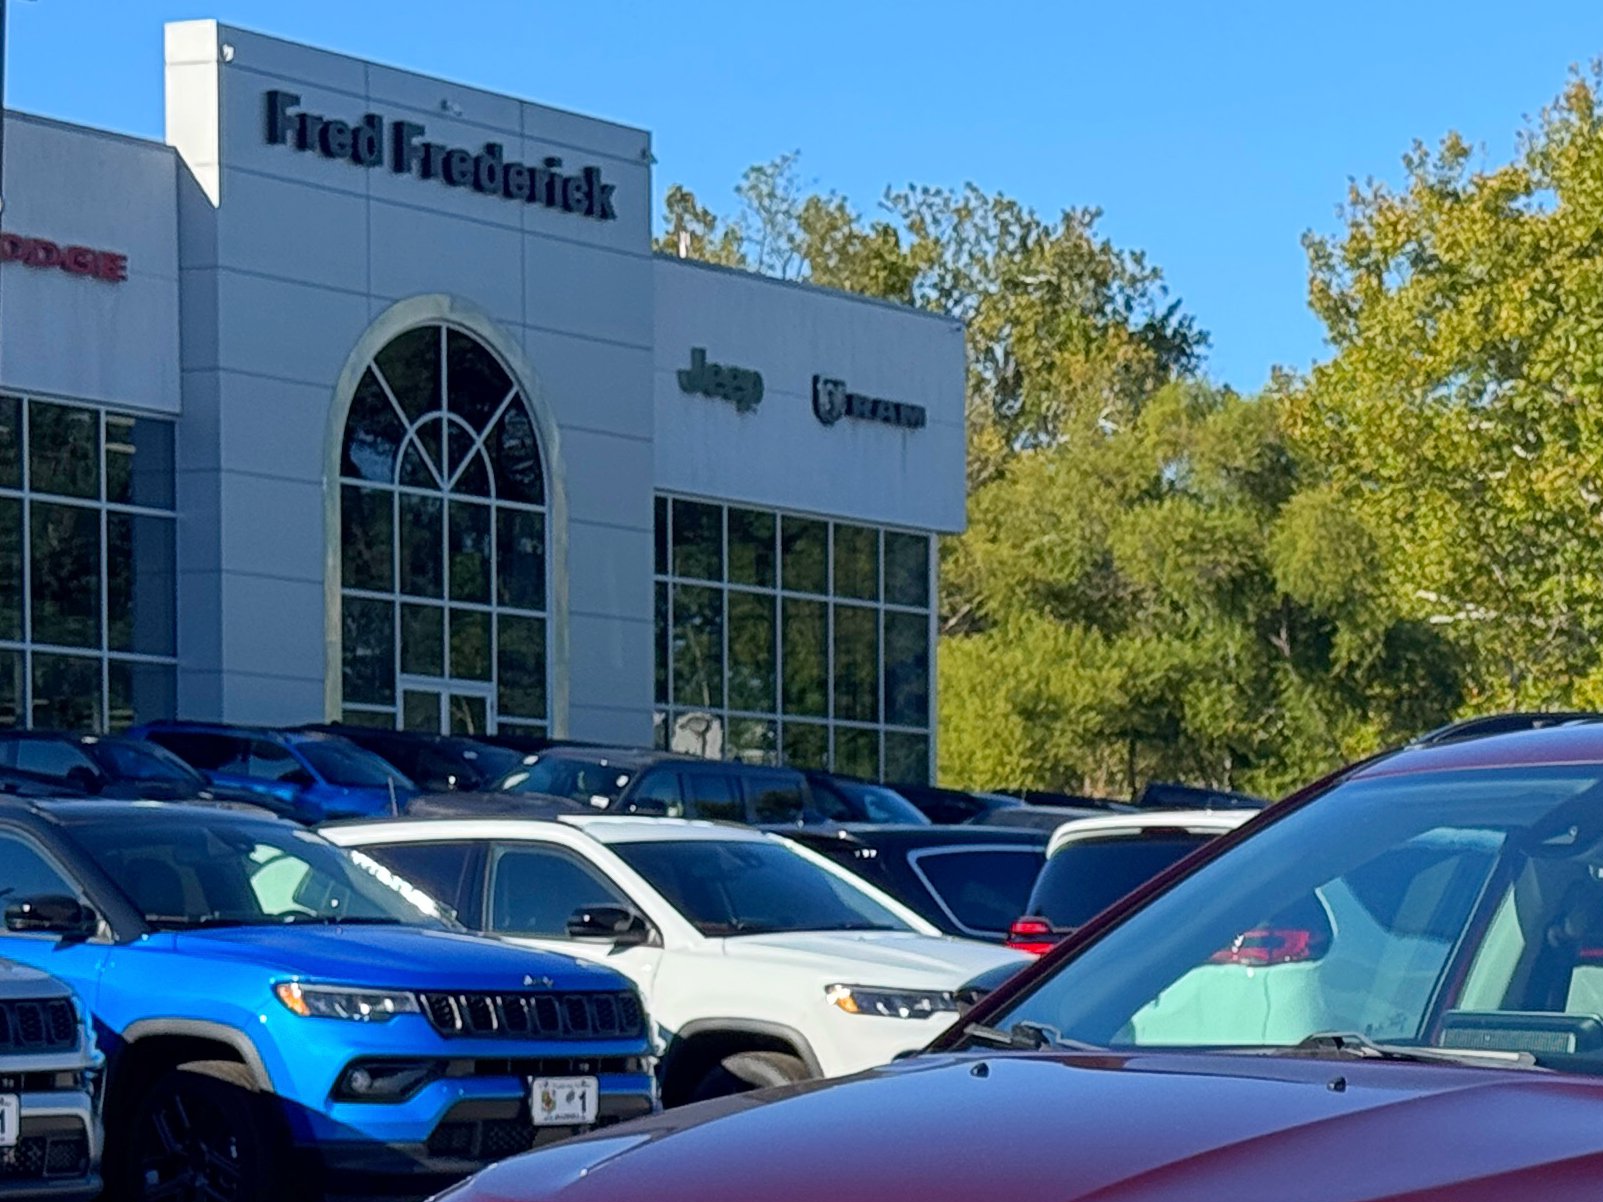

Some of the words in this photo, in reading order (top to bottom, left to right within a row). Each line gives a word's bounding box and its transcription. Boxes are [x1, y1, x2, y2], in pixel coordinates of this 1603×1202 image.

[265, 90, 383, 168] Fred
[391, 119, 617, 221] Frederick
[677, 347, 764, 414] Jeep
[845, 393, 926, 429] RAM
